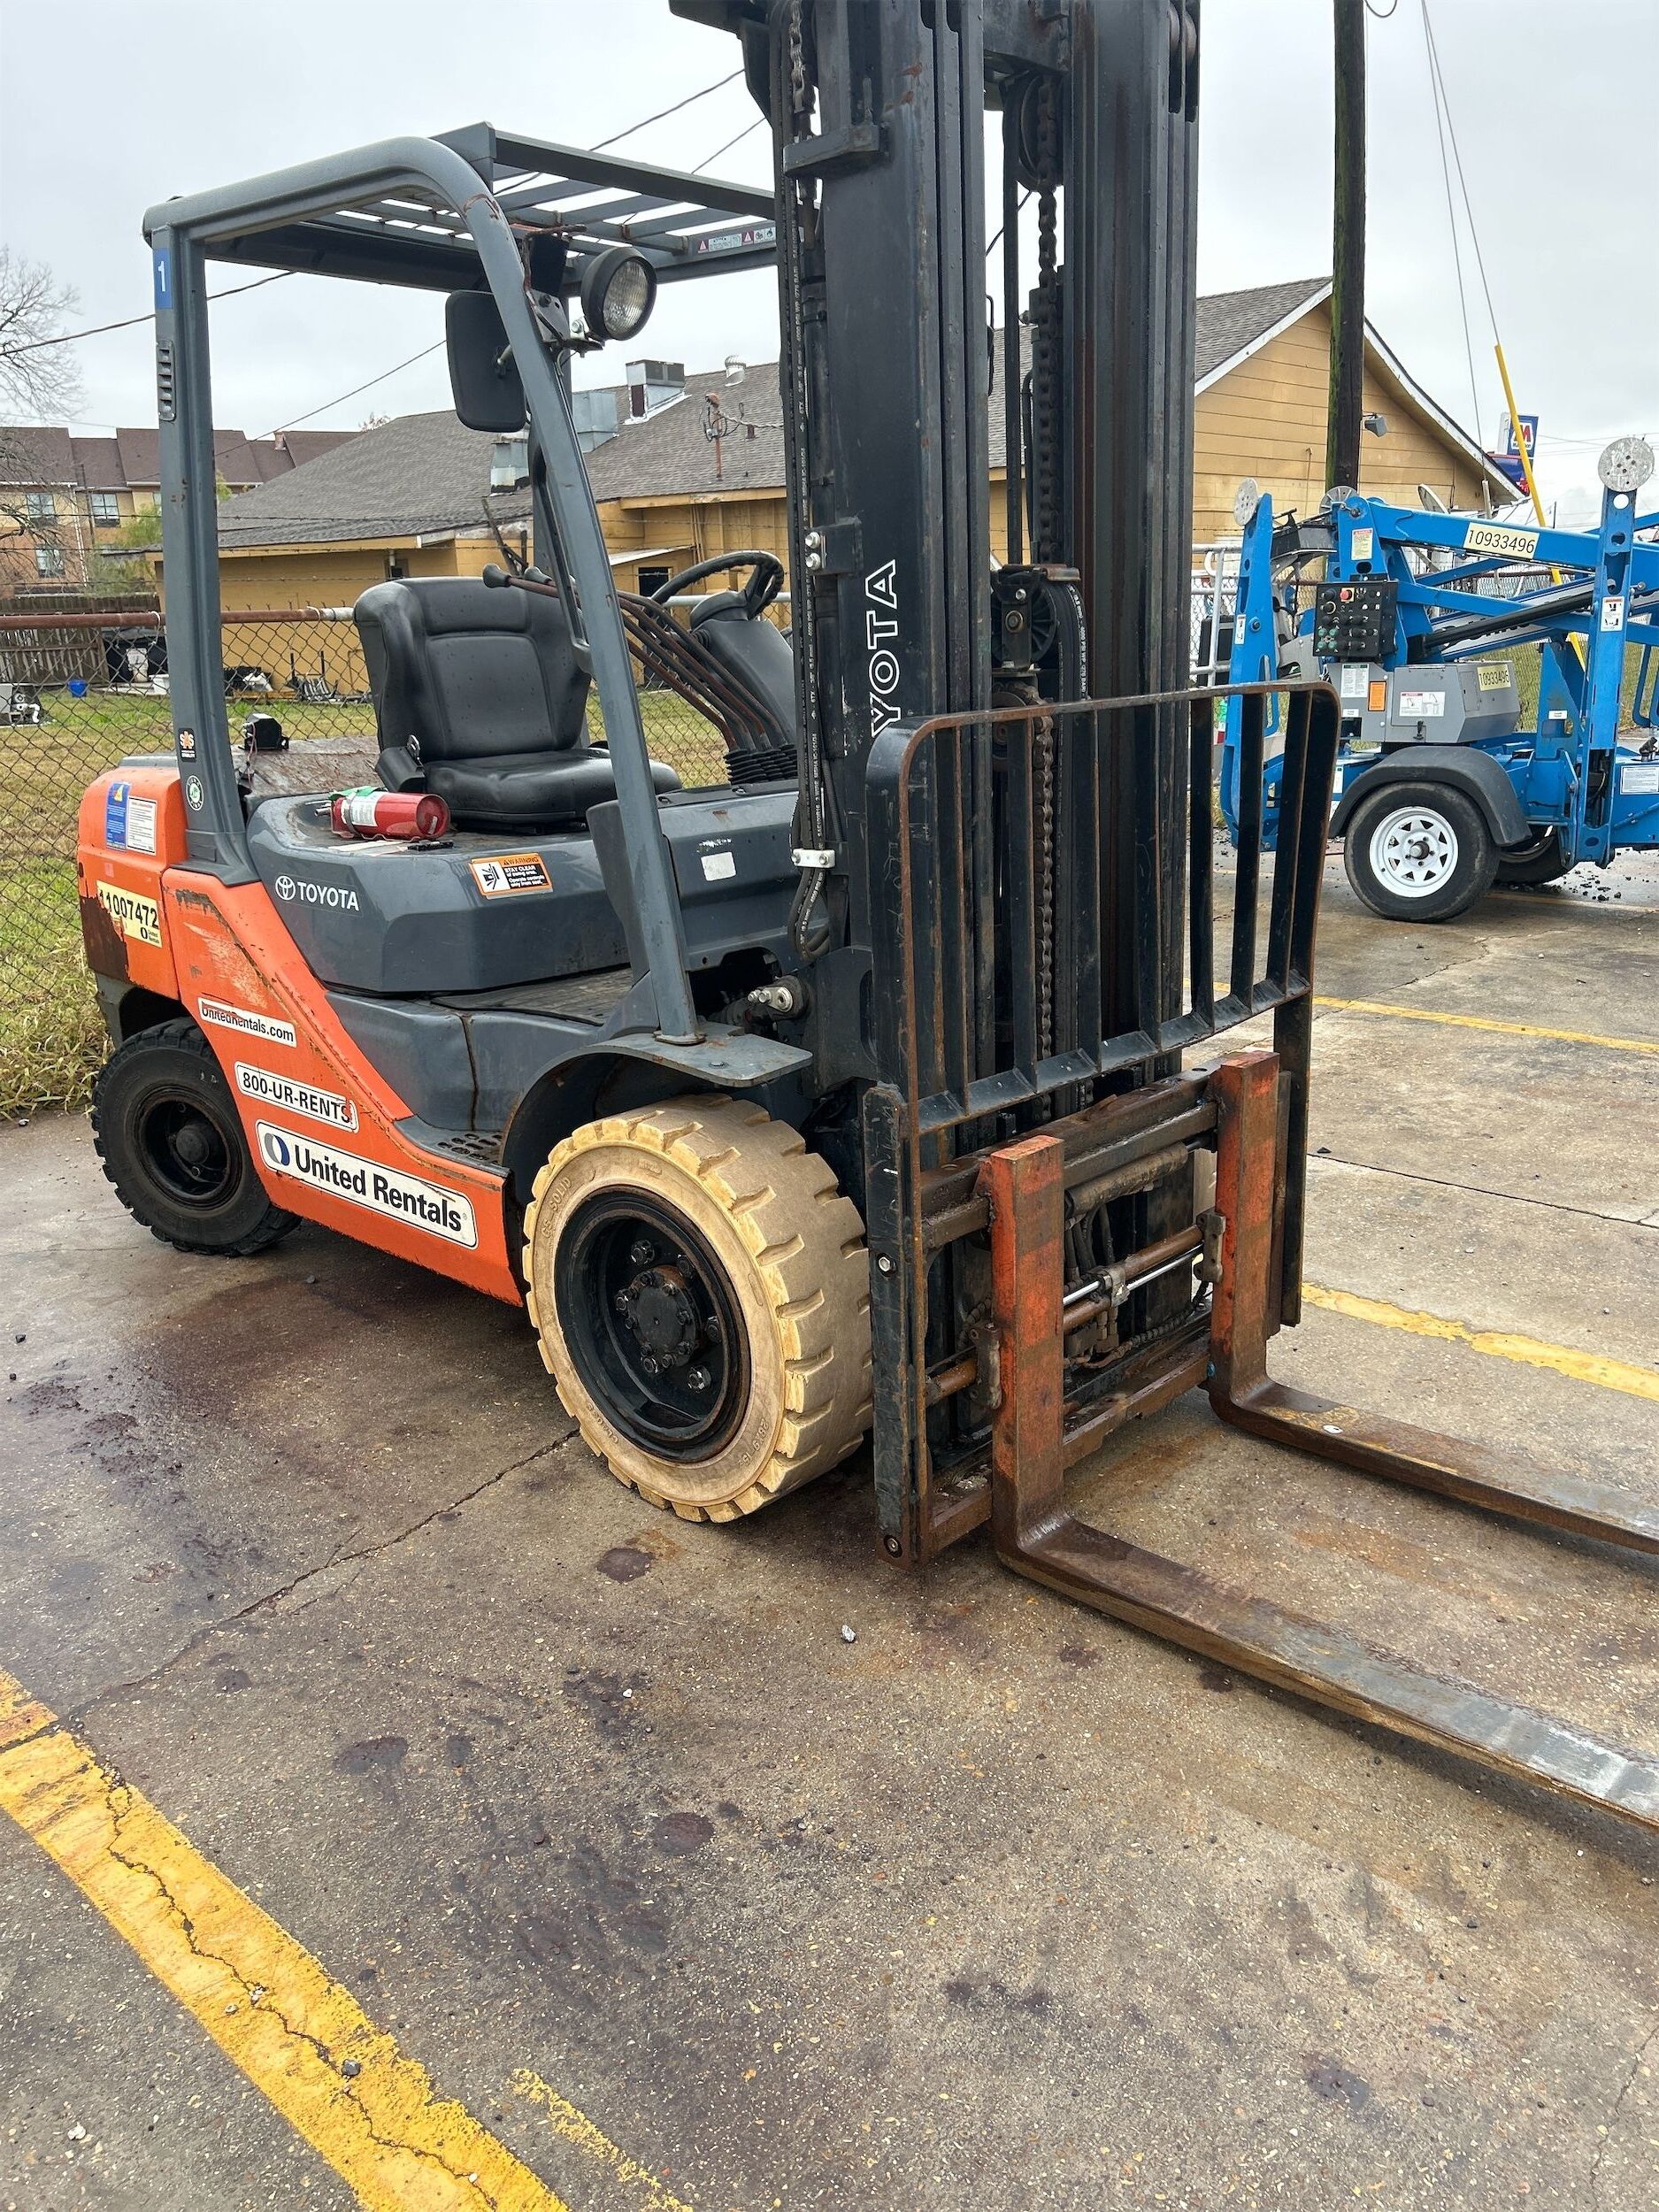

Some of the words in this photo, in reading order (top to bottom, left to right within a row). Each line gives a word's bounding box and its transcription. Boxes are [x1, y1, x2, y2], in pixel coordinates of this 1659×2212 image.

[157, 260, 166, 292] 1
[1469, 530, 1535, 554] 10933496
[1479, 670, 1509, 687] 10933496
[98, 888, 159, 928] 11007472
[298, 882, 359, 911] TOYOTA
[242, 1073, 352, 1125] 800-UR-RENTS
[295, 1146, 366, 1201] United
[373, 1169, 462, 1232] Rentals
